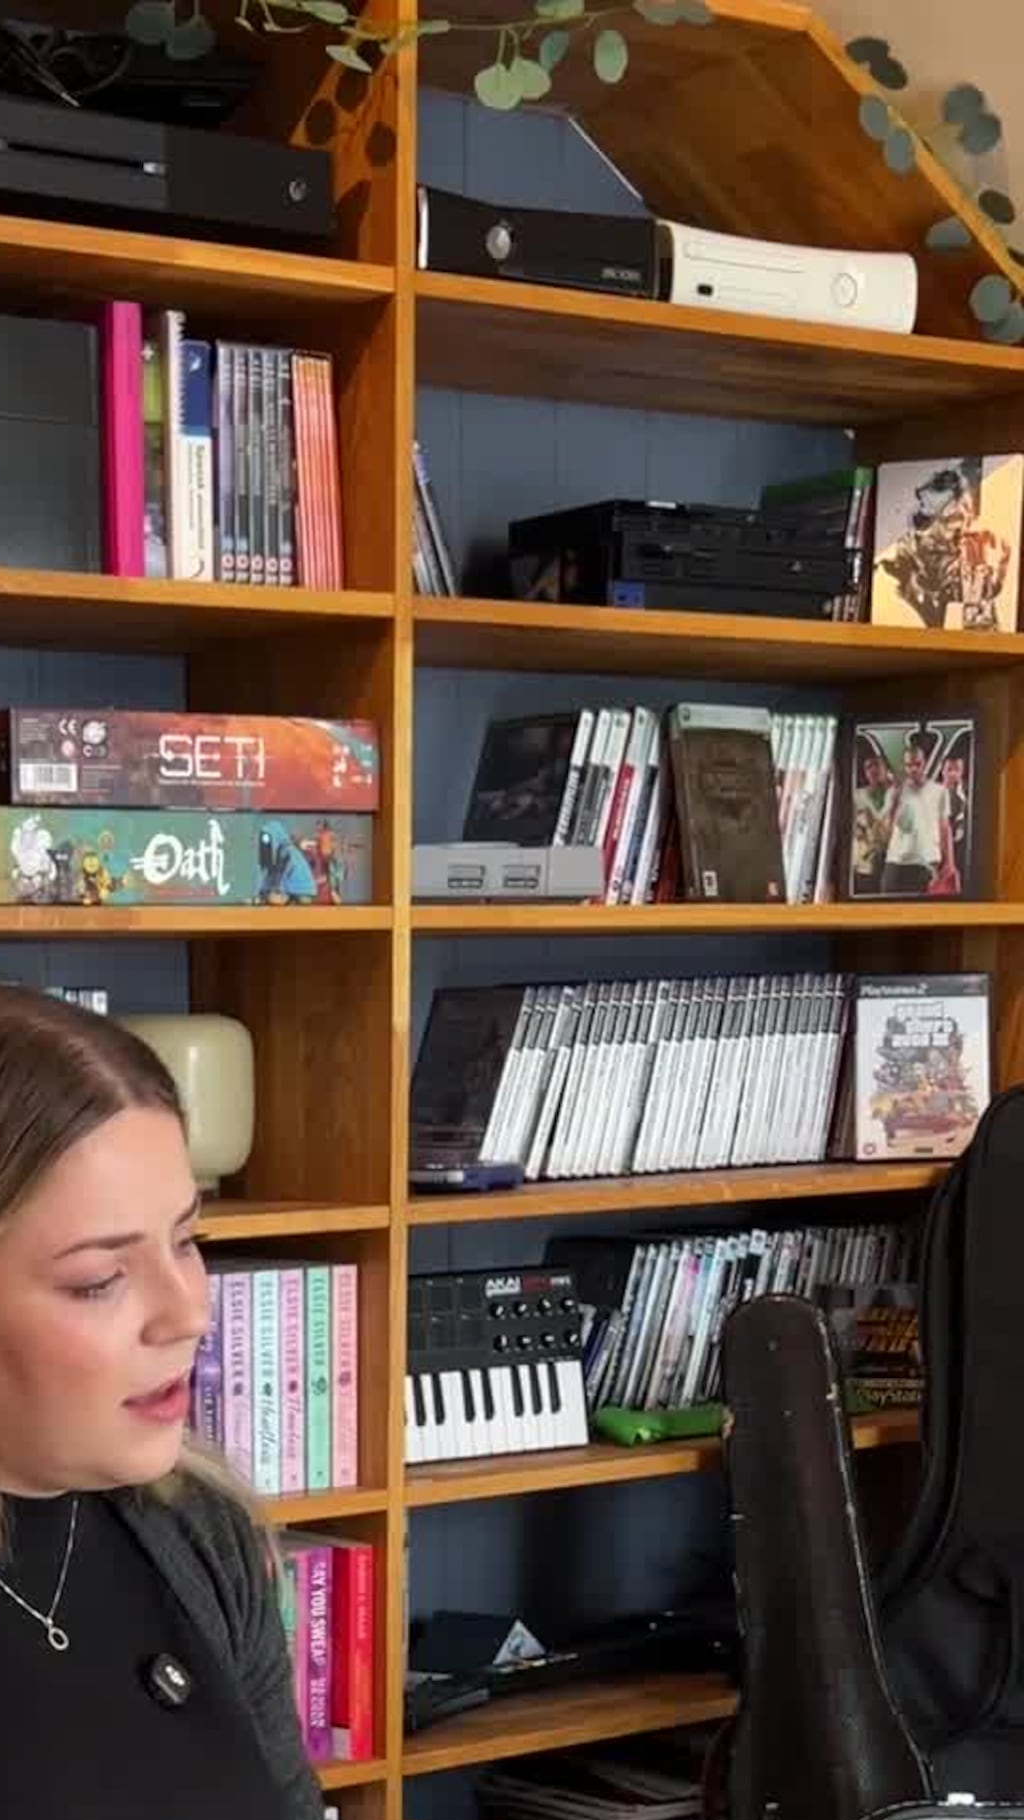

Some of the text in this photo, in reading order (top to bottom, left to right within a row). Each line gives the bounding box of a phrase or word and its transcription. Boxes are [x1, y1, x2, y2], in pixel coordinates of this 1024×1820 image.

[158, 734, 266, 779] SETI
[130, 819, 231, 896] Oath
[231, 1327, 245, 1378] SILVER
[311, 1587, 327, 1617] YOU
